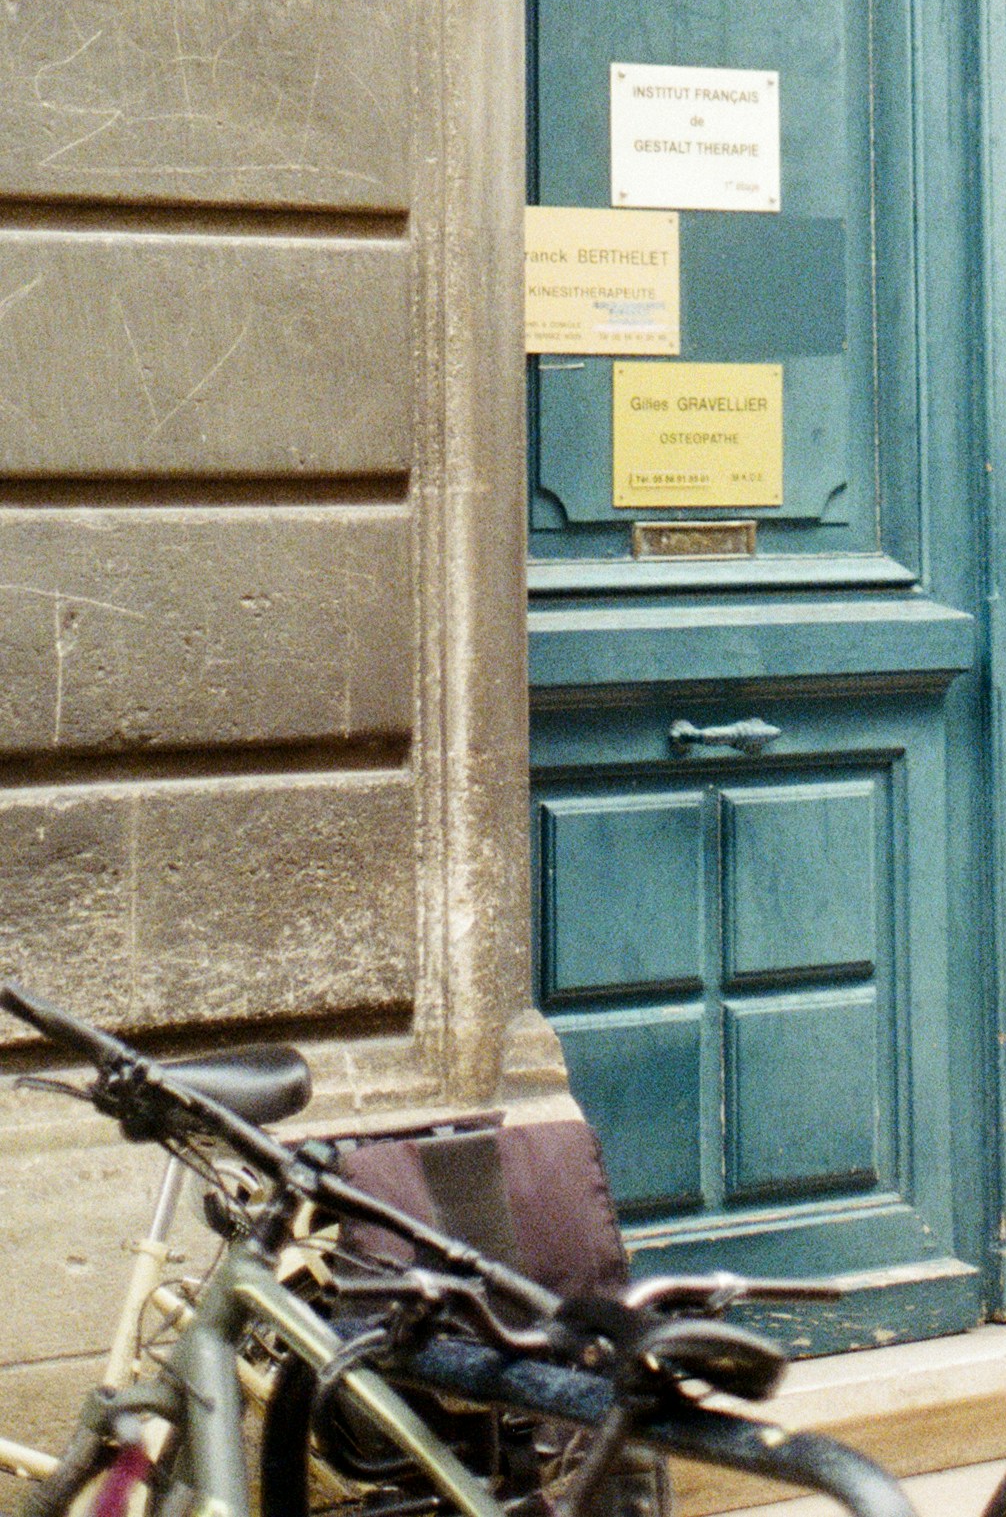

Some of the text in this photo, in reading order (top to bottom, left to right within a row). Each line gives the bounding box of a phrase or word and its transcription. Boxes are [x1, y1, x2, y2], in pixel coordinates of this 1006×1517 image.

[632, 85, 760, 104] INSTITUT FRANÇAIS
[689, 115, 705, 127] de
[633, 139, 760, 157] GESTALT THERAPIE
[523, 248, 670, 266] ranck BERTHELET
[528, 285, 657, 300] KINESITHERAPEUTE
[630, 395, 768, 412] Gilles GRAVELLIER
[659, 432, 739, 445] OSTEOPATHE
